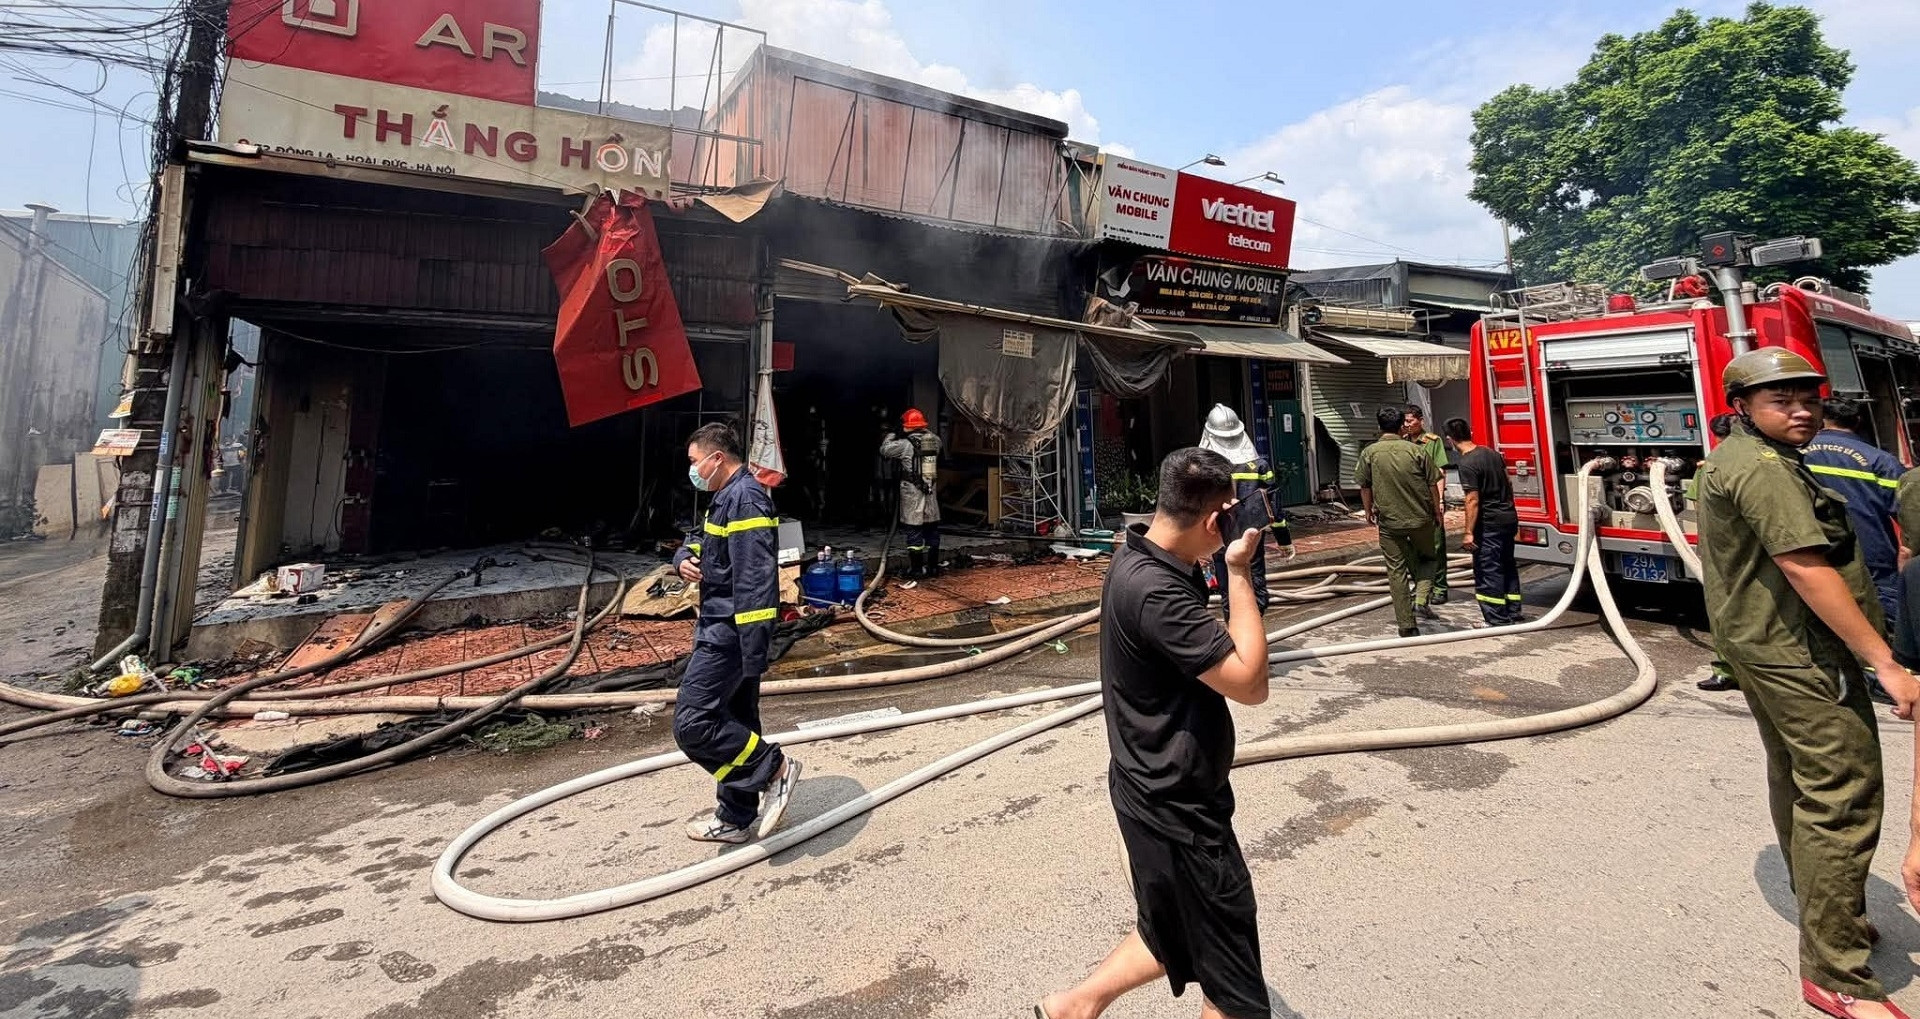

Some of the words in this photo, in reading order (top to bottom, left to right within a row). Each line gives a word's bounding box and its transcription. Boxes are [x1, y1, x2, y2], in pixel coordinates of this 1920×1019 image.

[415, 13, 527, 66] AR
[334, 104, 538, 162] THẮNG
[1108, 184, 1131, 200] VĂN
[1133, 191, 1170, 208] CHUNG
[1116, 203, 1158, 220] MOBILE
[1201, 198, 1275, 233] viettel
[1228, 232, 1271, 253] telecom
[1146, 260, 1178, 283] VĂN
[1180, 267, 1232, 289] CHUNG
[1234, 274, 1281, 294] MOBILE
[1632, 556, 1656, 569] 29A
